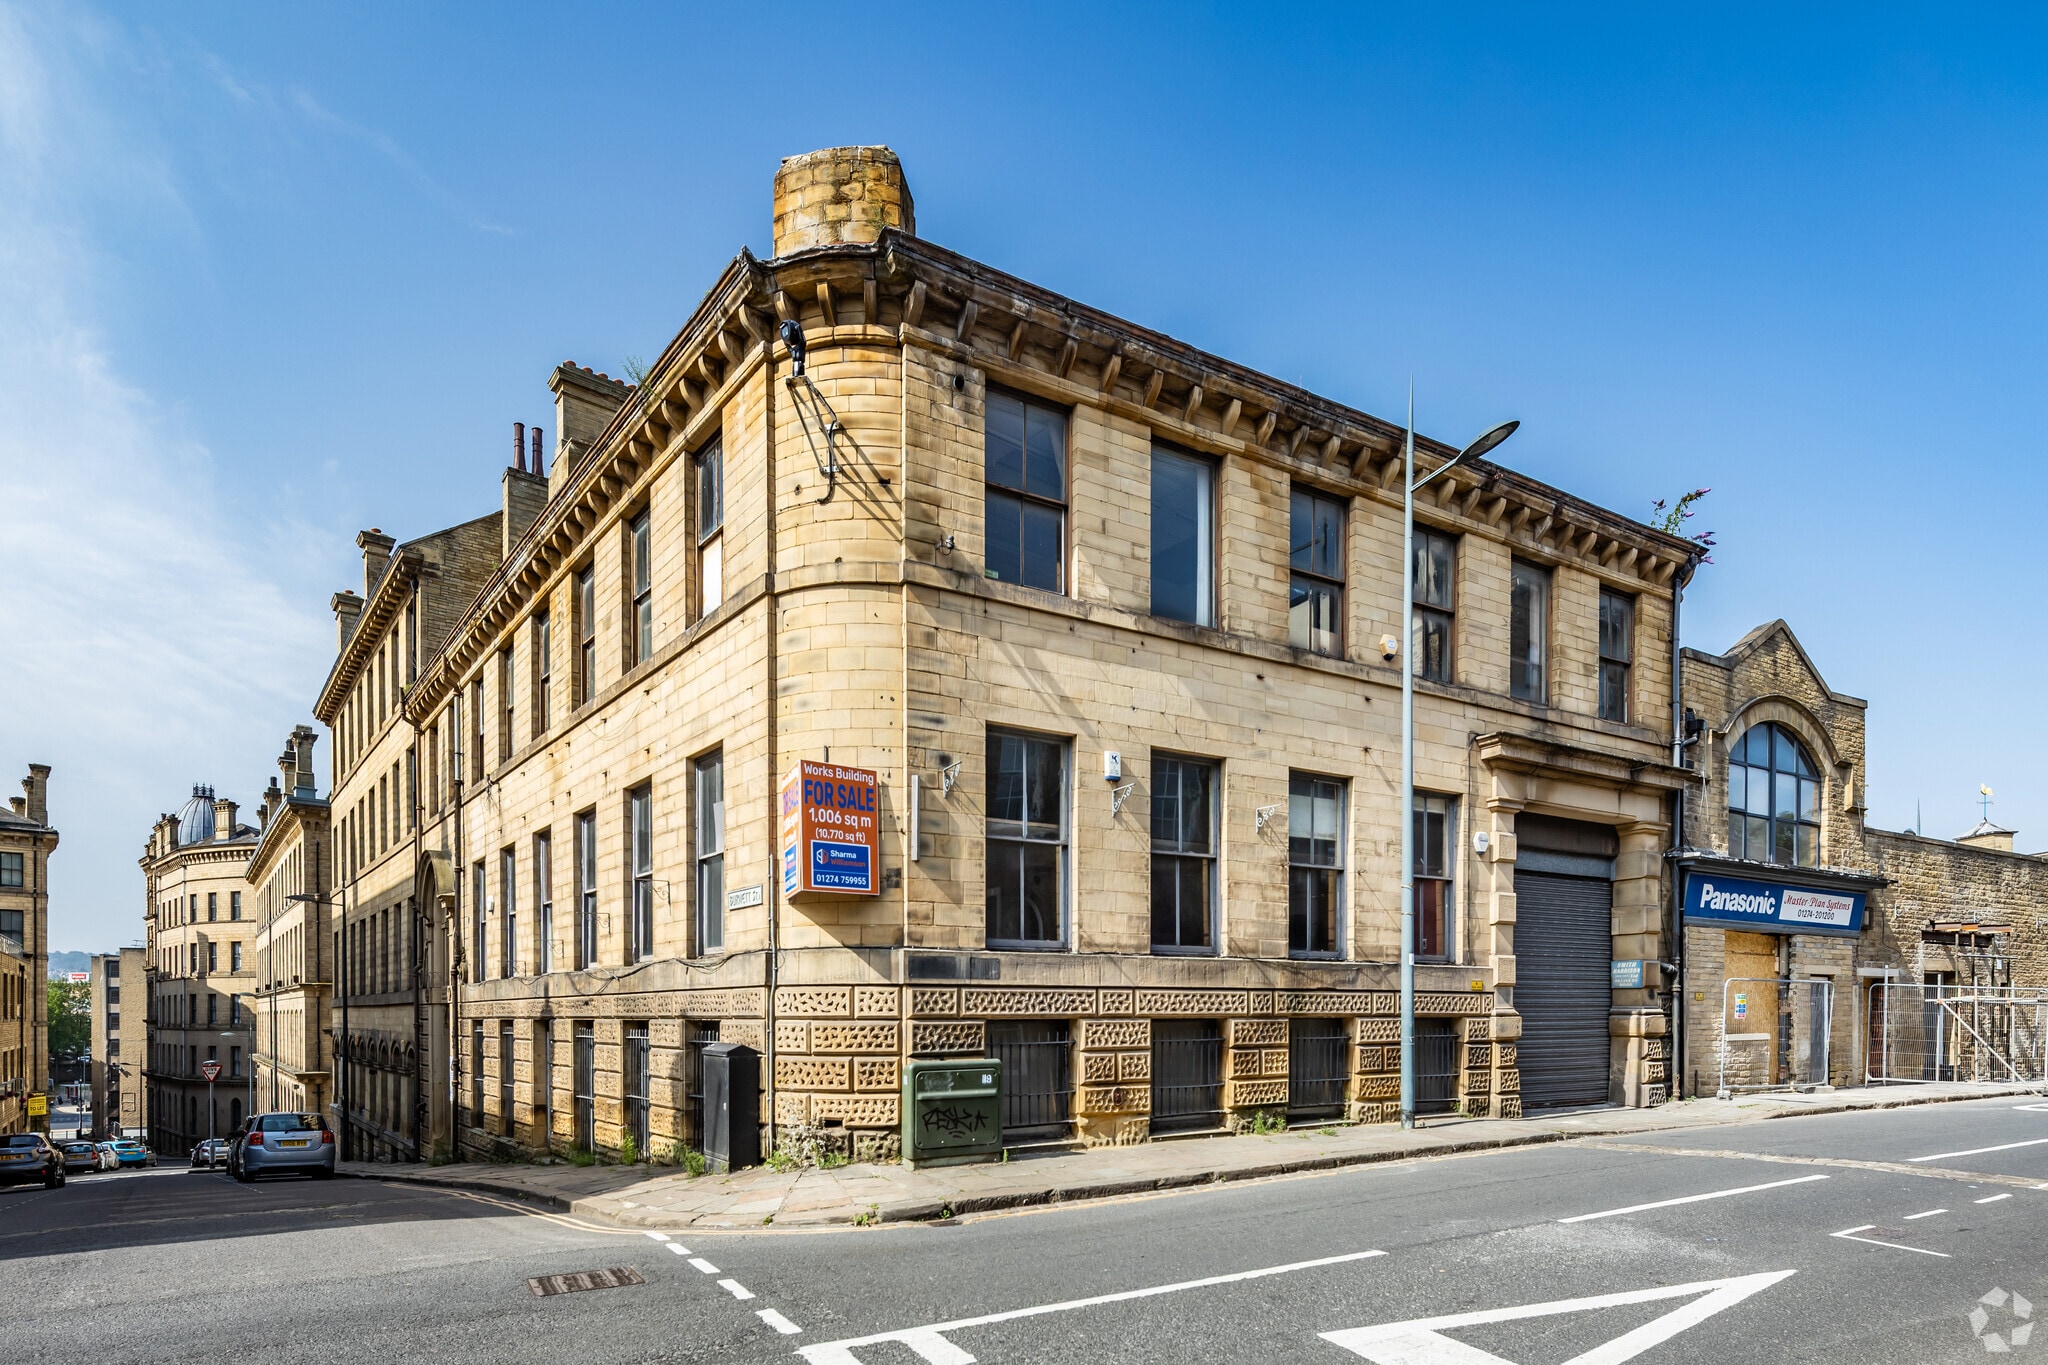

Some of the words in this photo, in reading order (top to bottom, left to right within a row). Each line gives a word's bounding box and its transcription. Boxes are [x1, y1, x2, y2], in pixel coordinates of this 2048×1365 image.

[804, 763, 833, 778] Works
[836, 768, 874, 786] Building
[804, 779, 834, 807] FOR
[837, 784, 875, 812] SALE
[809, 808, 842, 825] 1,006
[844, 814, 858, 829] sq
[861, 817, 872, 828] m
[845, 832, 855, 843] sq
[856, 831, 866, 844] ft)
[830, 850, 857, 859] Sharma
[830, 858, 866, 868] Williamson
[816, 874, 839, 884] 01274
[841, 875, 867, 885] 759955
[1699, 883, 1776, 915] Panasonic
[1784, 895, 1808, 907] Master
[1809, 896, 1826, 908] Plan
[1826, 899, 1851, 911] Systems
[1797, 909, 1835, 920] 01274-201200
